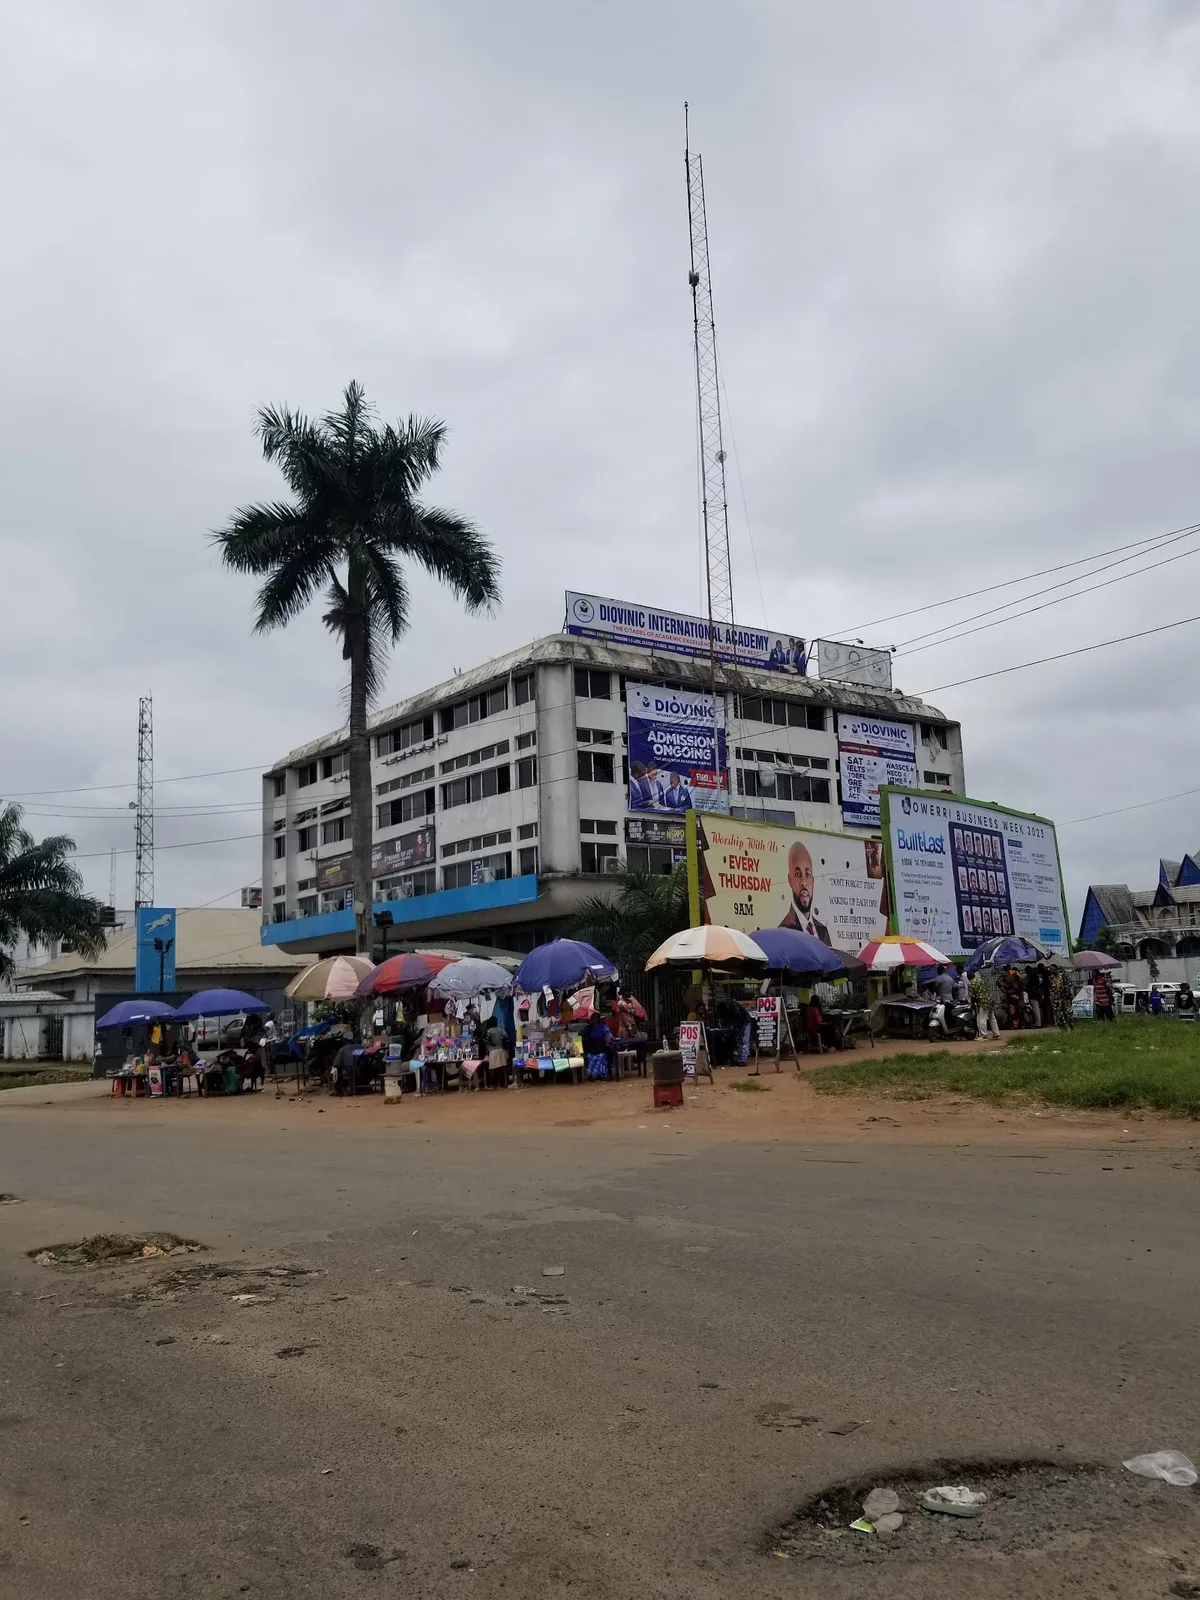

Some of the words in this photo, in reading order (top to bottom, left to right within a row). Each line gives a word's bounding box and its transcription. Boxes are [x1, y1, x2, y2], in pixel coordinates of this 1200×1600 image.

[600, 604, 645, 629] DIOVINIC
[649, 613, 723, 642] INTERNATIONAL
[725, 629, 769, 652] ACADEMY
[613, 625, 624, 633] THE
[624, 627, 646, 637] CITADEL
[654, 633, 683, 643] ACADEMIC
[684, 639, 711, 648] EXCELLENC
[655, 699, 714, 719] DIOVINIC
[860, 722, 907, 740] DIOVINIC
[647, 731, 715, 749] ADMISSION
[653, 744, 711, 759] ONGOING
[847, 756, 864, 766] SAT
[886, 762, 909, 772] WASSCE
[847, 764, 866, 774] IELTS
[848, 772, 867, 780] TOEFL
[886, 770, 902, 778] NECO
[848, 778, 863, 787] GRE
[848, 786, 861, 794] PTE
[912, 801, 952, 819] OWERRI
[956, 810, 998, 829] BUSINESS
[1002, 820, 1025, 835] WEEK
[1027, 825, 1045, 839] 2023
[711, 831, 744, 849] Worship
[747, 837, 766, 851] With
[767, 841, 778, 853] Us
[729, 854, 760, 873] EVERY
[718, 872, 772, 893] THURSDAY
[845, 879, 863, 889] FORGET
[863, 881, 876, 890] THAT
[733, 901, 754, 916] 9AM
[848, 898, 857, 907] UP
[857, 899, 869, 907] EACH
[833, 914, 838, 924] IS
[838, 915, 849, 924] THE
[849, 916, 862, 925] FIRST
[862, 916, 877, 926] THING
[836, 930, 845, 939] WE
[845, 931, 864, 940] SHOULD
[758, 997, 777, 1013] POS
[680, 1026, 698, 1040] POS
